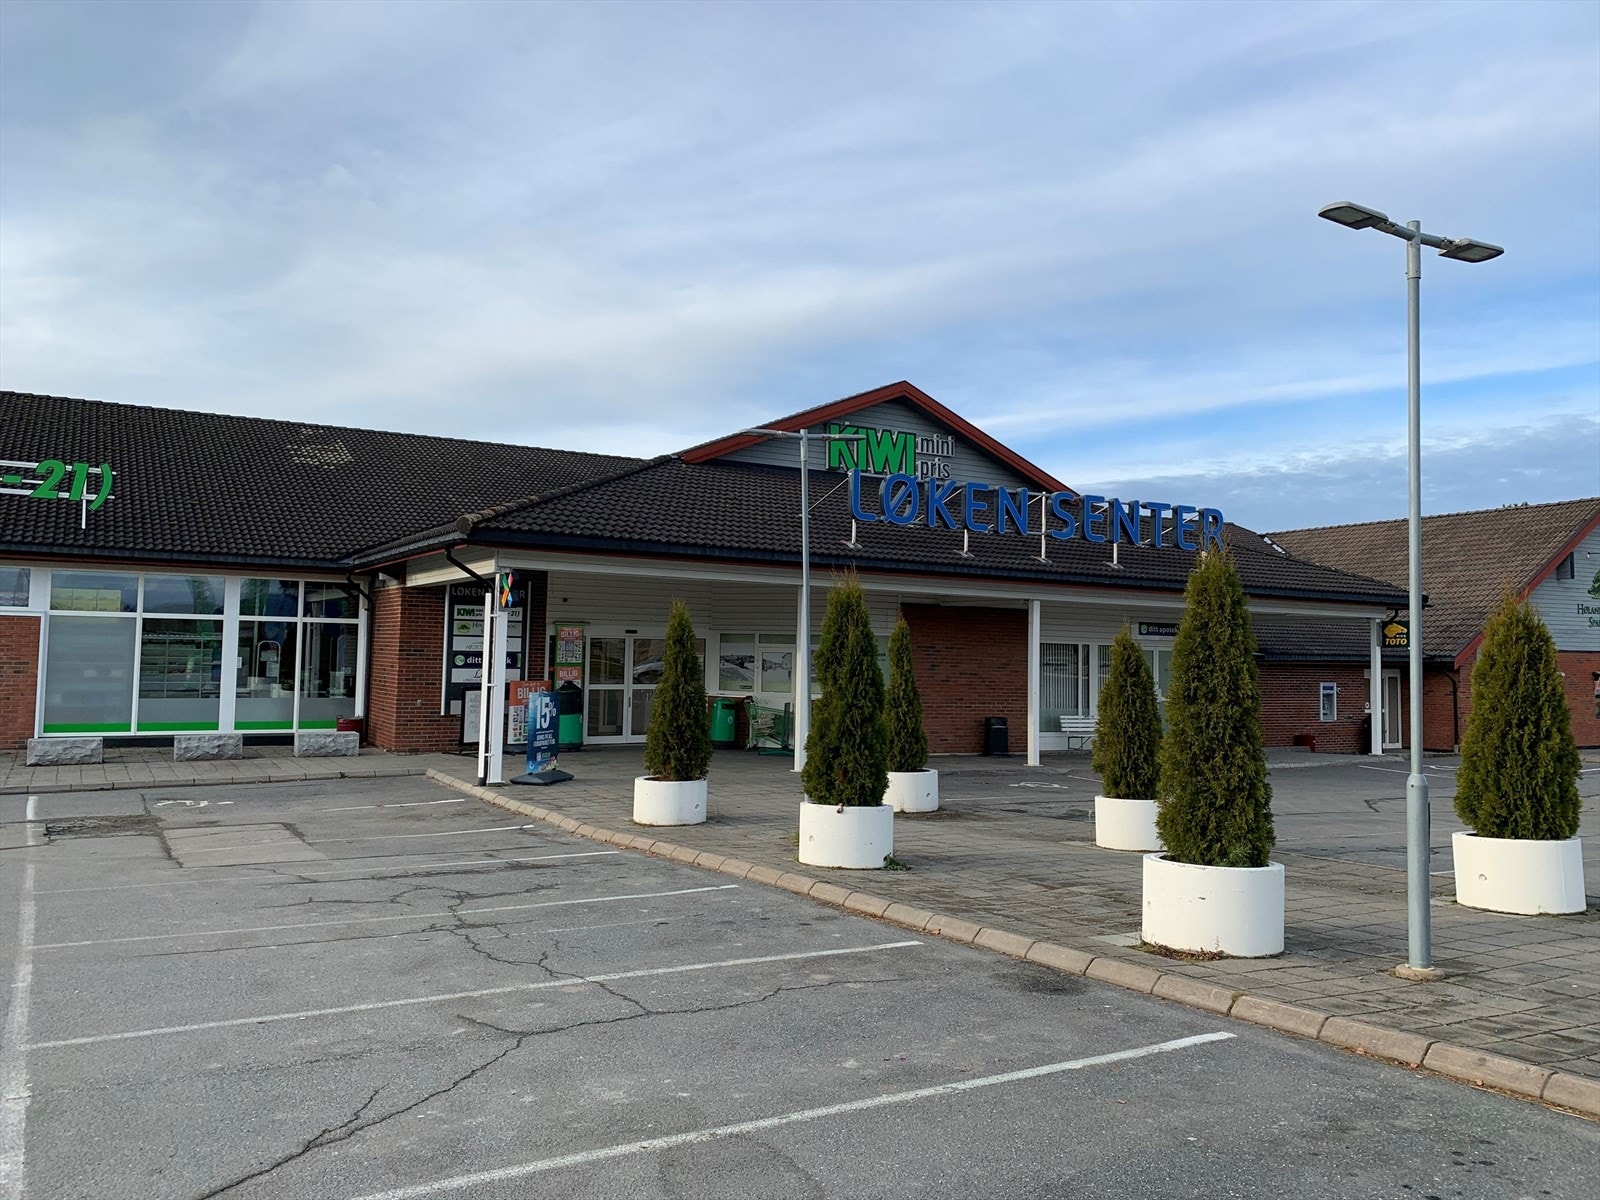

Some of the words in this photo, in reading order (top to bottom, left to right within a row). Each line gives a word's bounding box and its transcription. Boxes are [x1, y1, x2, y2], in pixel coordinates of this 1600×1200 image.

[827, 423, 917, 477] KIWI
[918, 434, 955, 457] mini
[918, 458, 951, 480] pris
[850, 468, 1028, 536] LØKEN
[1051, 491, 1224, 552] SENTER
[456, 607, 475, 617] KIWI
[1385, 637, 1408, 645] TOTO
[466, 656, 482, 664] ditt
[535, 696, 557, 730] 15%
